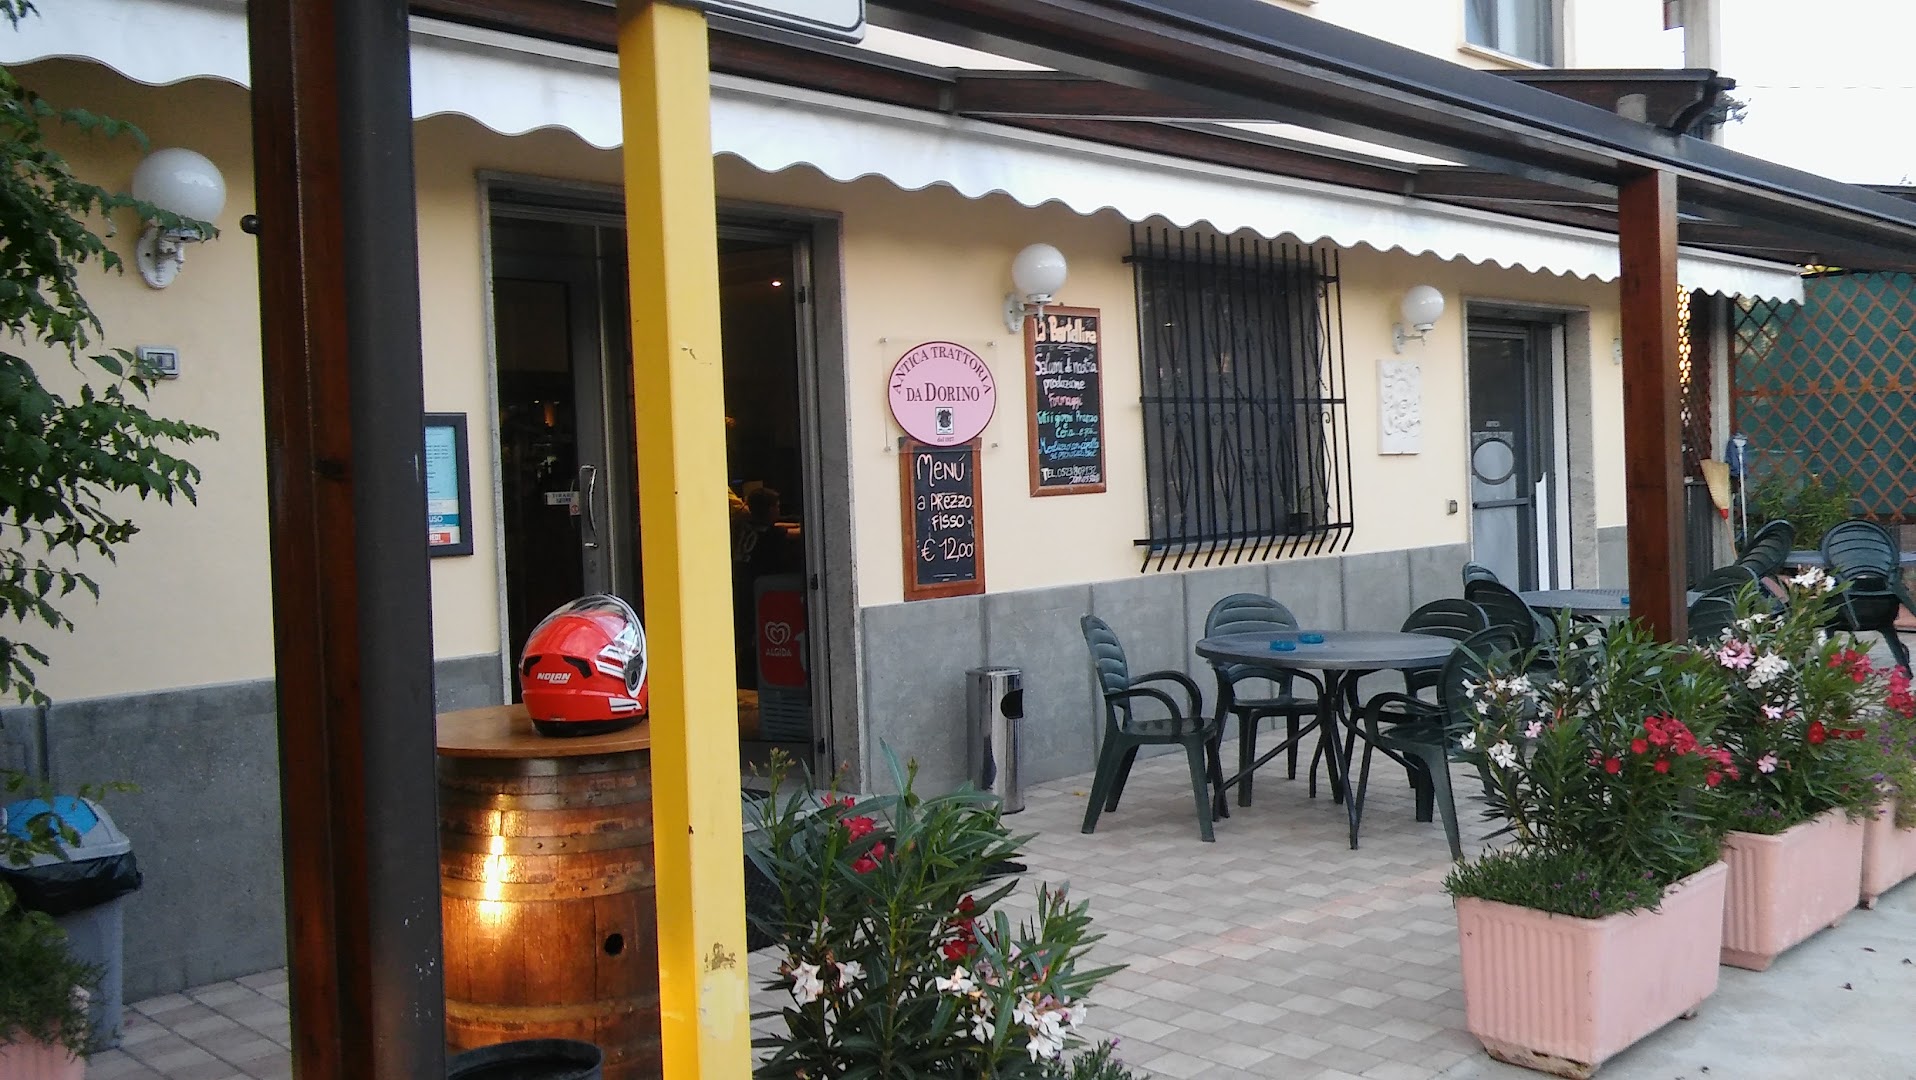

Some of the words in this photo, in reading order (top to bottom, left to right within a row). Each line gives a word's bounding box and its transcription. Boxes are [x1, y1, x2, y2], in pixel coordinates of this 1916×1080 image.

[893, 349, 929, 394] ANTICA
[931, 346, 992, 394] TRATTORIA
[906, 387, 922, 402] DA
[921, 538, 936, 562] €
[938, 537, 974, 563] 12,00
[766, 647, 792, 657] ALGIDA
[537, 672, 571, 684] NOLAN
